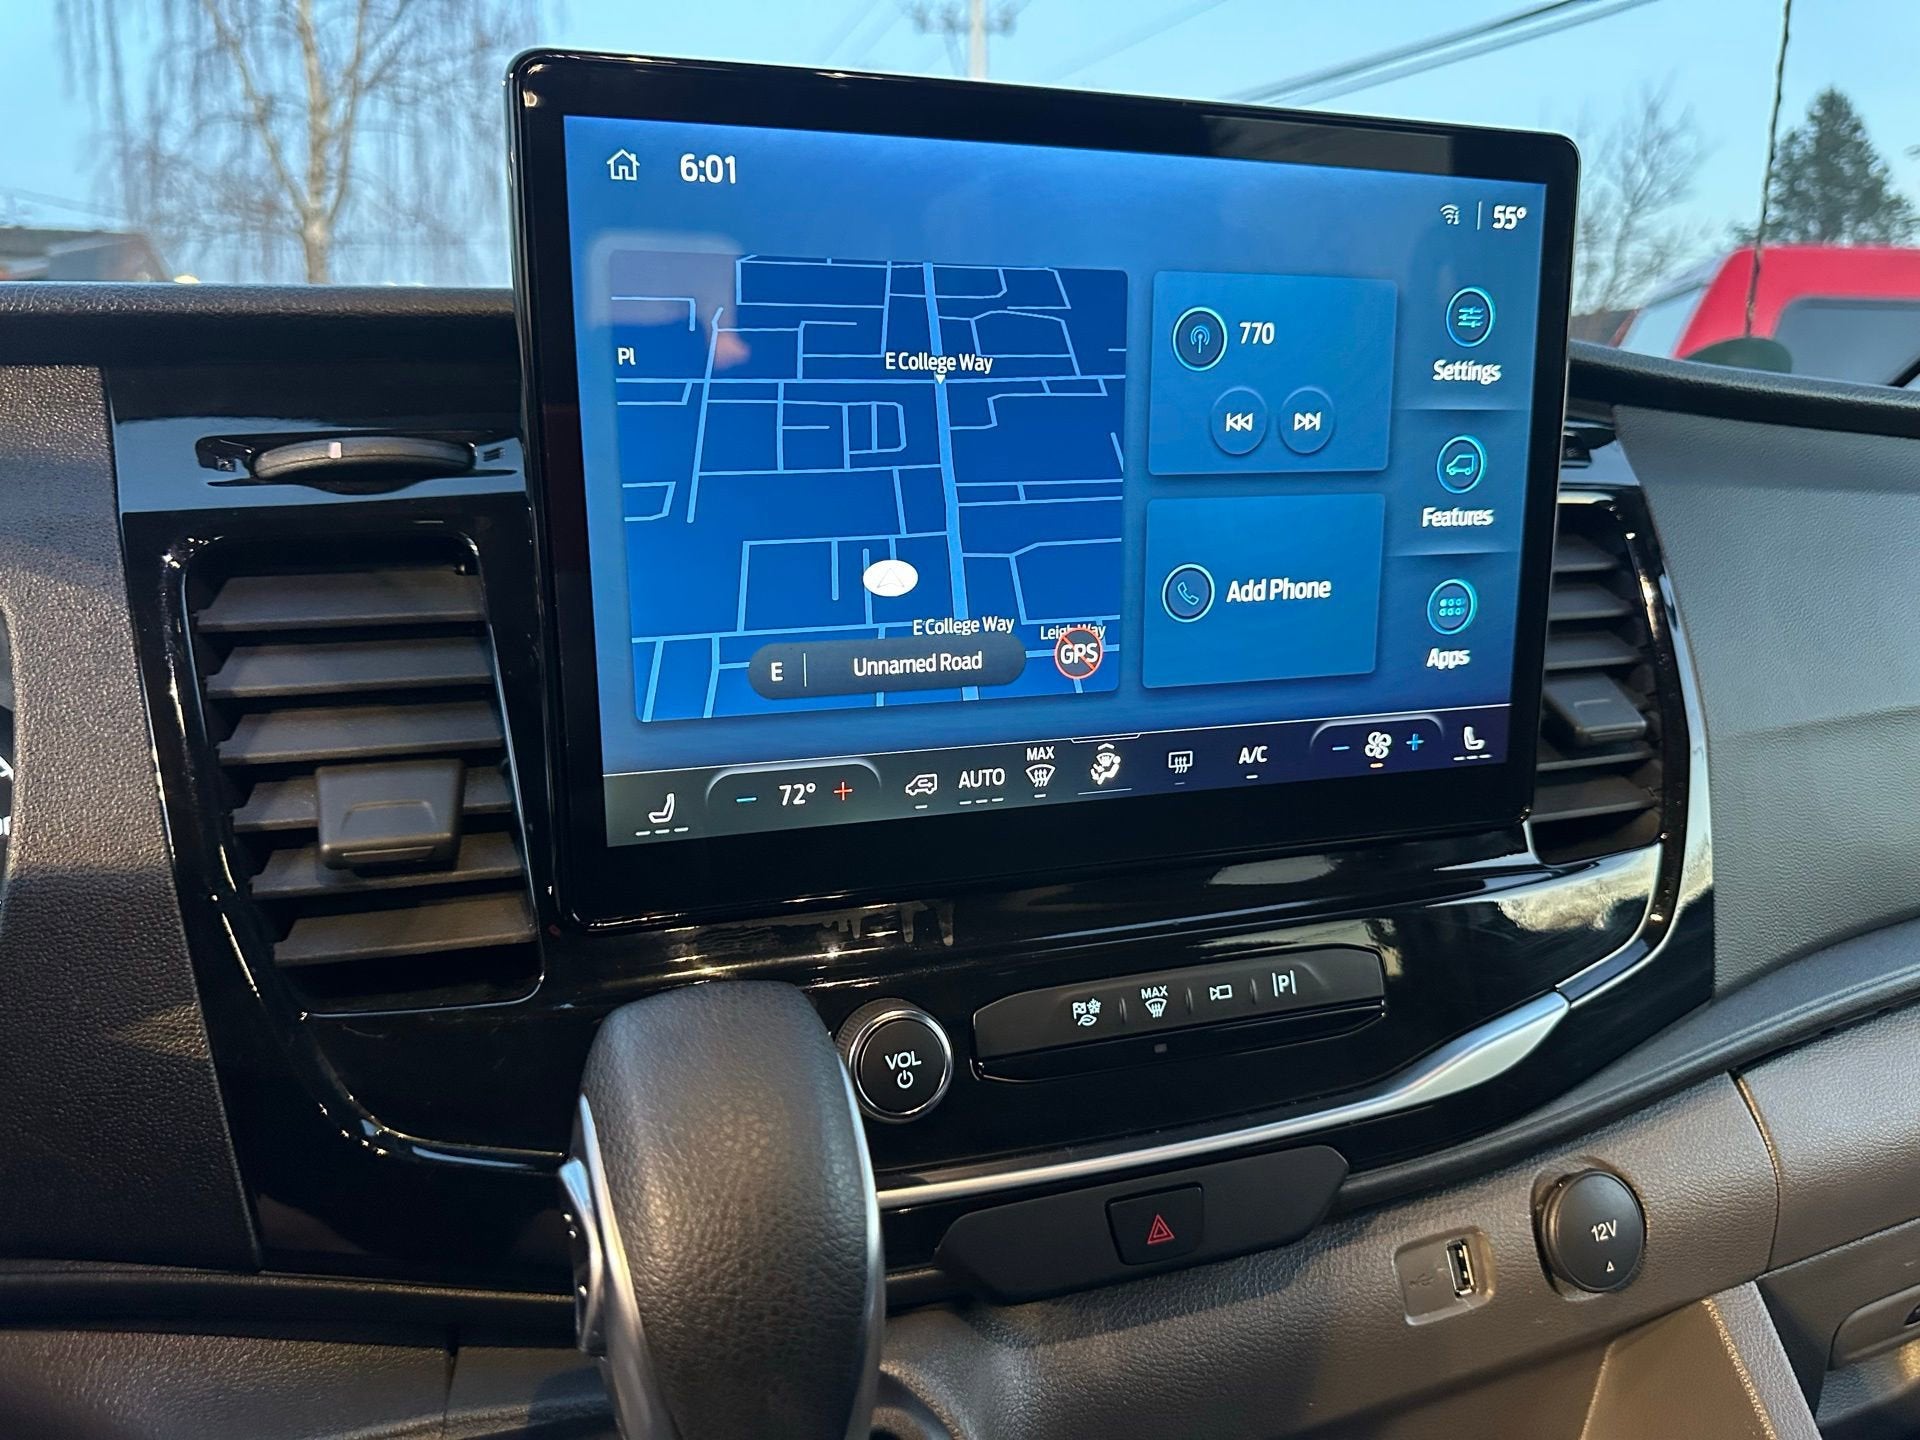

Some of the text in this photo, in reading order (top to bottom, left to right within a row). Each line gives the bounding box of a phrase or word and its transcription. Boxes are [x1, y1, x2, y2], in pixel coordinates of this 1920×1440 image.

[679, 153, 737, 186] 6:01
[1239, 321, 1276, 345] 770
[616, 347, 636, 366] Pl
[885, 353, 994, 374] E College Way
[1433, 360, 1501, 385] Settings
[1422, 507, 1493, 528] Features
[1227, 578, 1332, 603] Add Phone
[912, 615, 1015, 636] E College Way
[1060, 642, 1099, 665] GPS
[1426, 648, 1471, 669] Apps
[772, 663, 783, 682] E
[854, 651, 983, 678] Unnamed Road
[1026, 747, 1055, 761] MAX
[1239, 746, 1268, 766] A/C
[959, 768, 1005, 789] AUTO
[780, 784, 816, 807] 72°
[1141, 986, 1170, 1000] MAX
[885, 1051, 922, 1069] VOL
[1591, 1219, 1617, 1242] 12V
